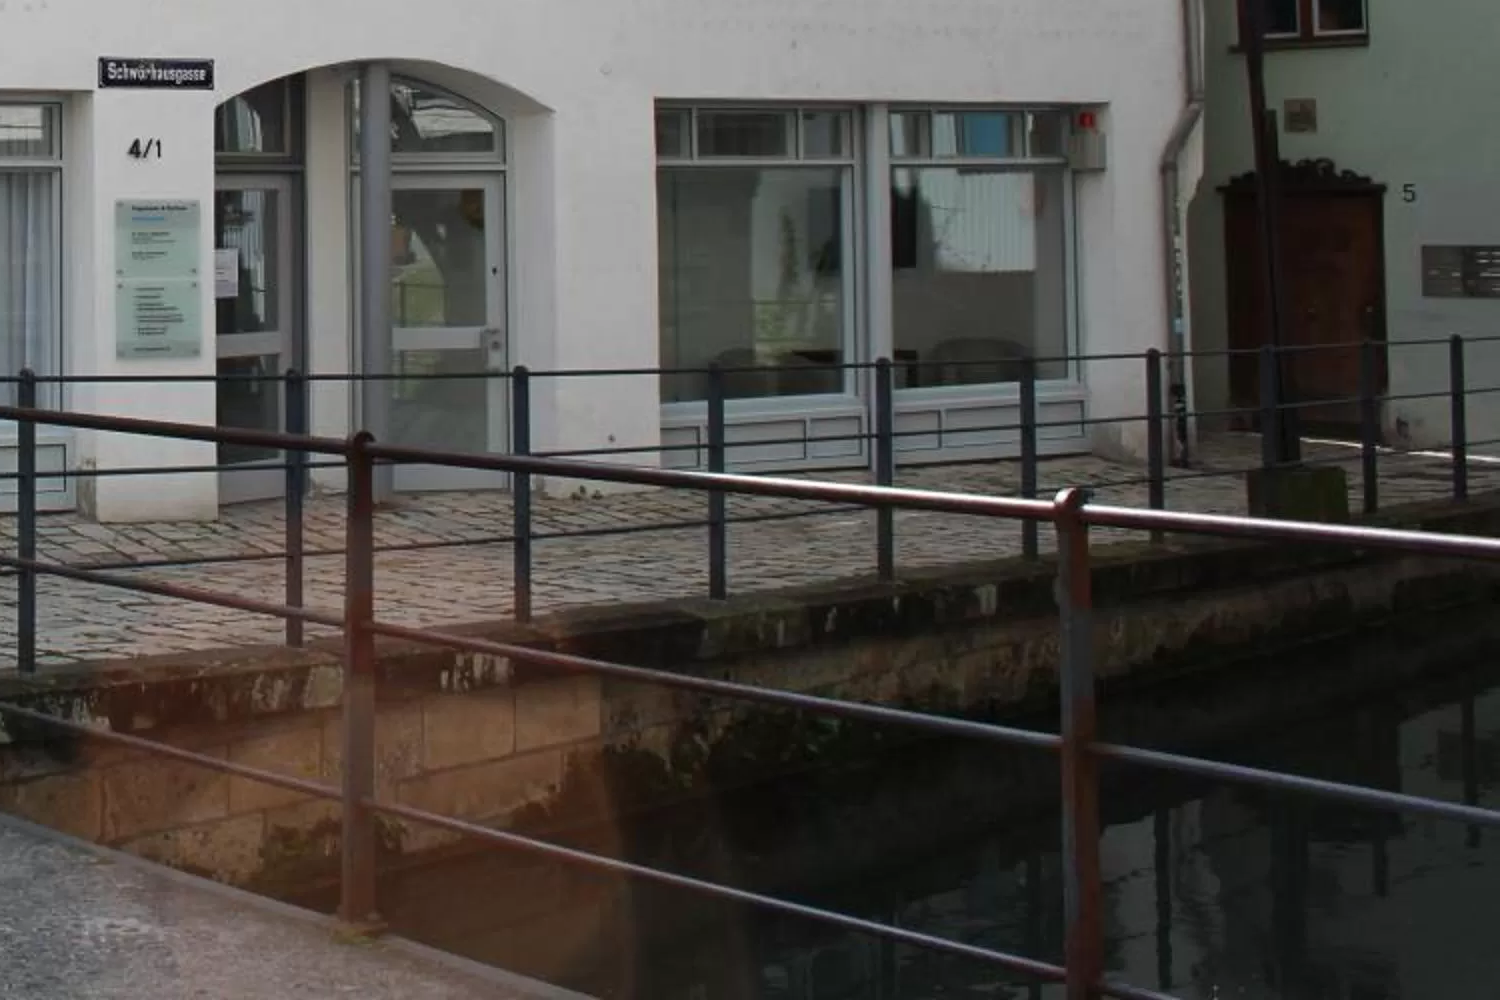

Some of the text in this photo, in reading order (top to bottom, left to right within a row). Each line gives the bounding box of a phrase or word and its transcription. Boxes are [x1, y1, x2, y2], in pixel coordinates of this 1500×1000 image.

[107, 61, 207, 85] Schwörhausgasse
[128, 138, 163, 159] 4/1
[1403, 183, 1416, 203] 5
